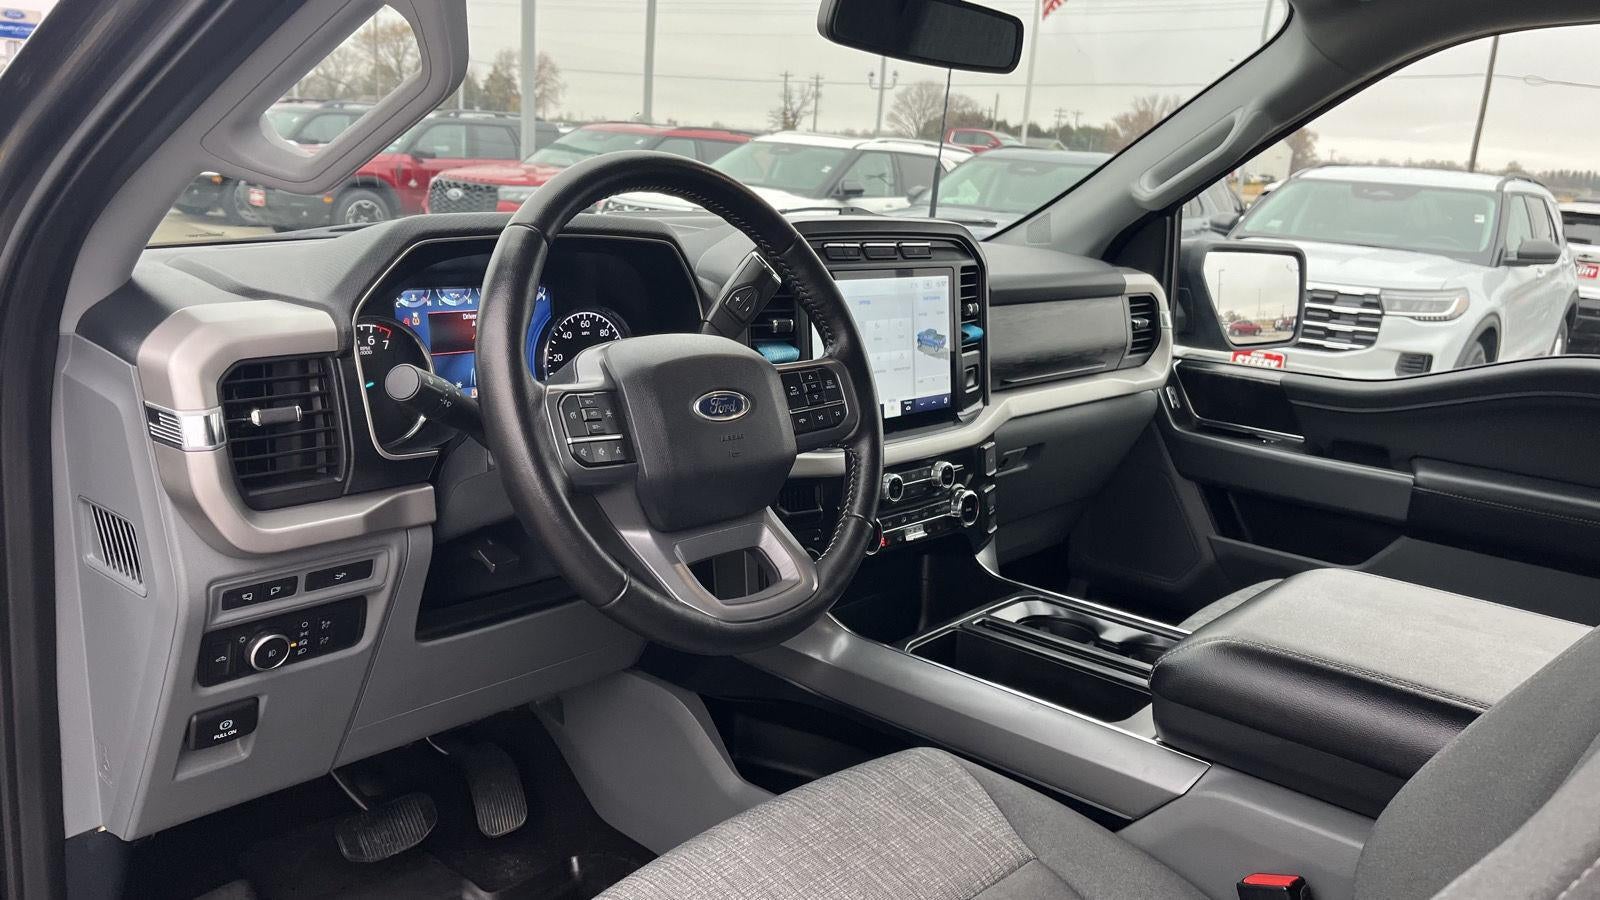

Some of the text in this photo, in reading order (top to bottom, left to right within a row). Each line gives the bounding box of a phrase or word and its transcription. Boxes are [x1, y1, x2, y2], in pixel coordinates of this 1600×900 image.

[580, 320, 590, 328] 60
[599, 329, 609, 337] 80
[367, 336, 375, 346] 6
[382, 340, 389, 350] 7
[710, 397, 737, 414] Ford
